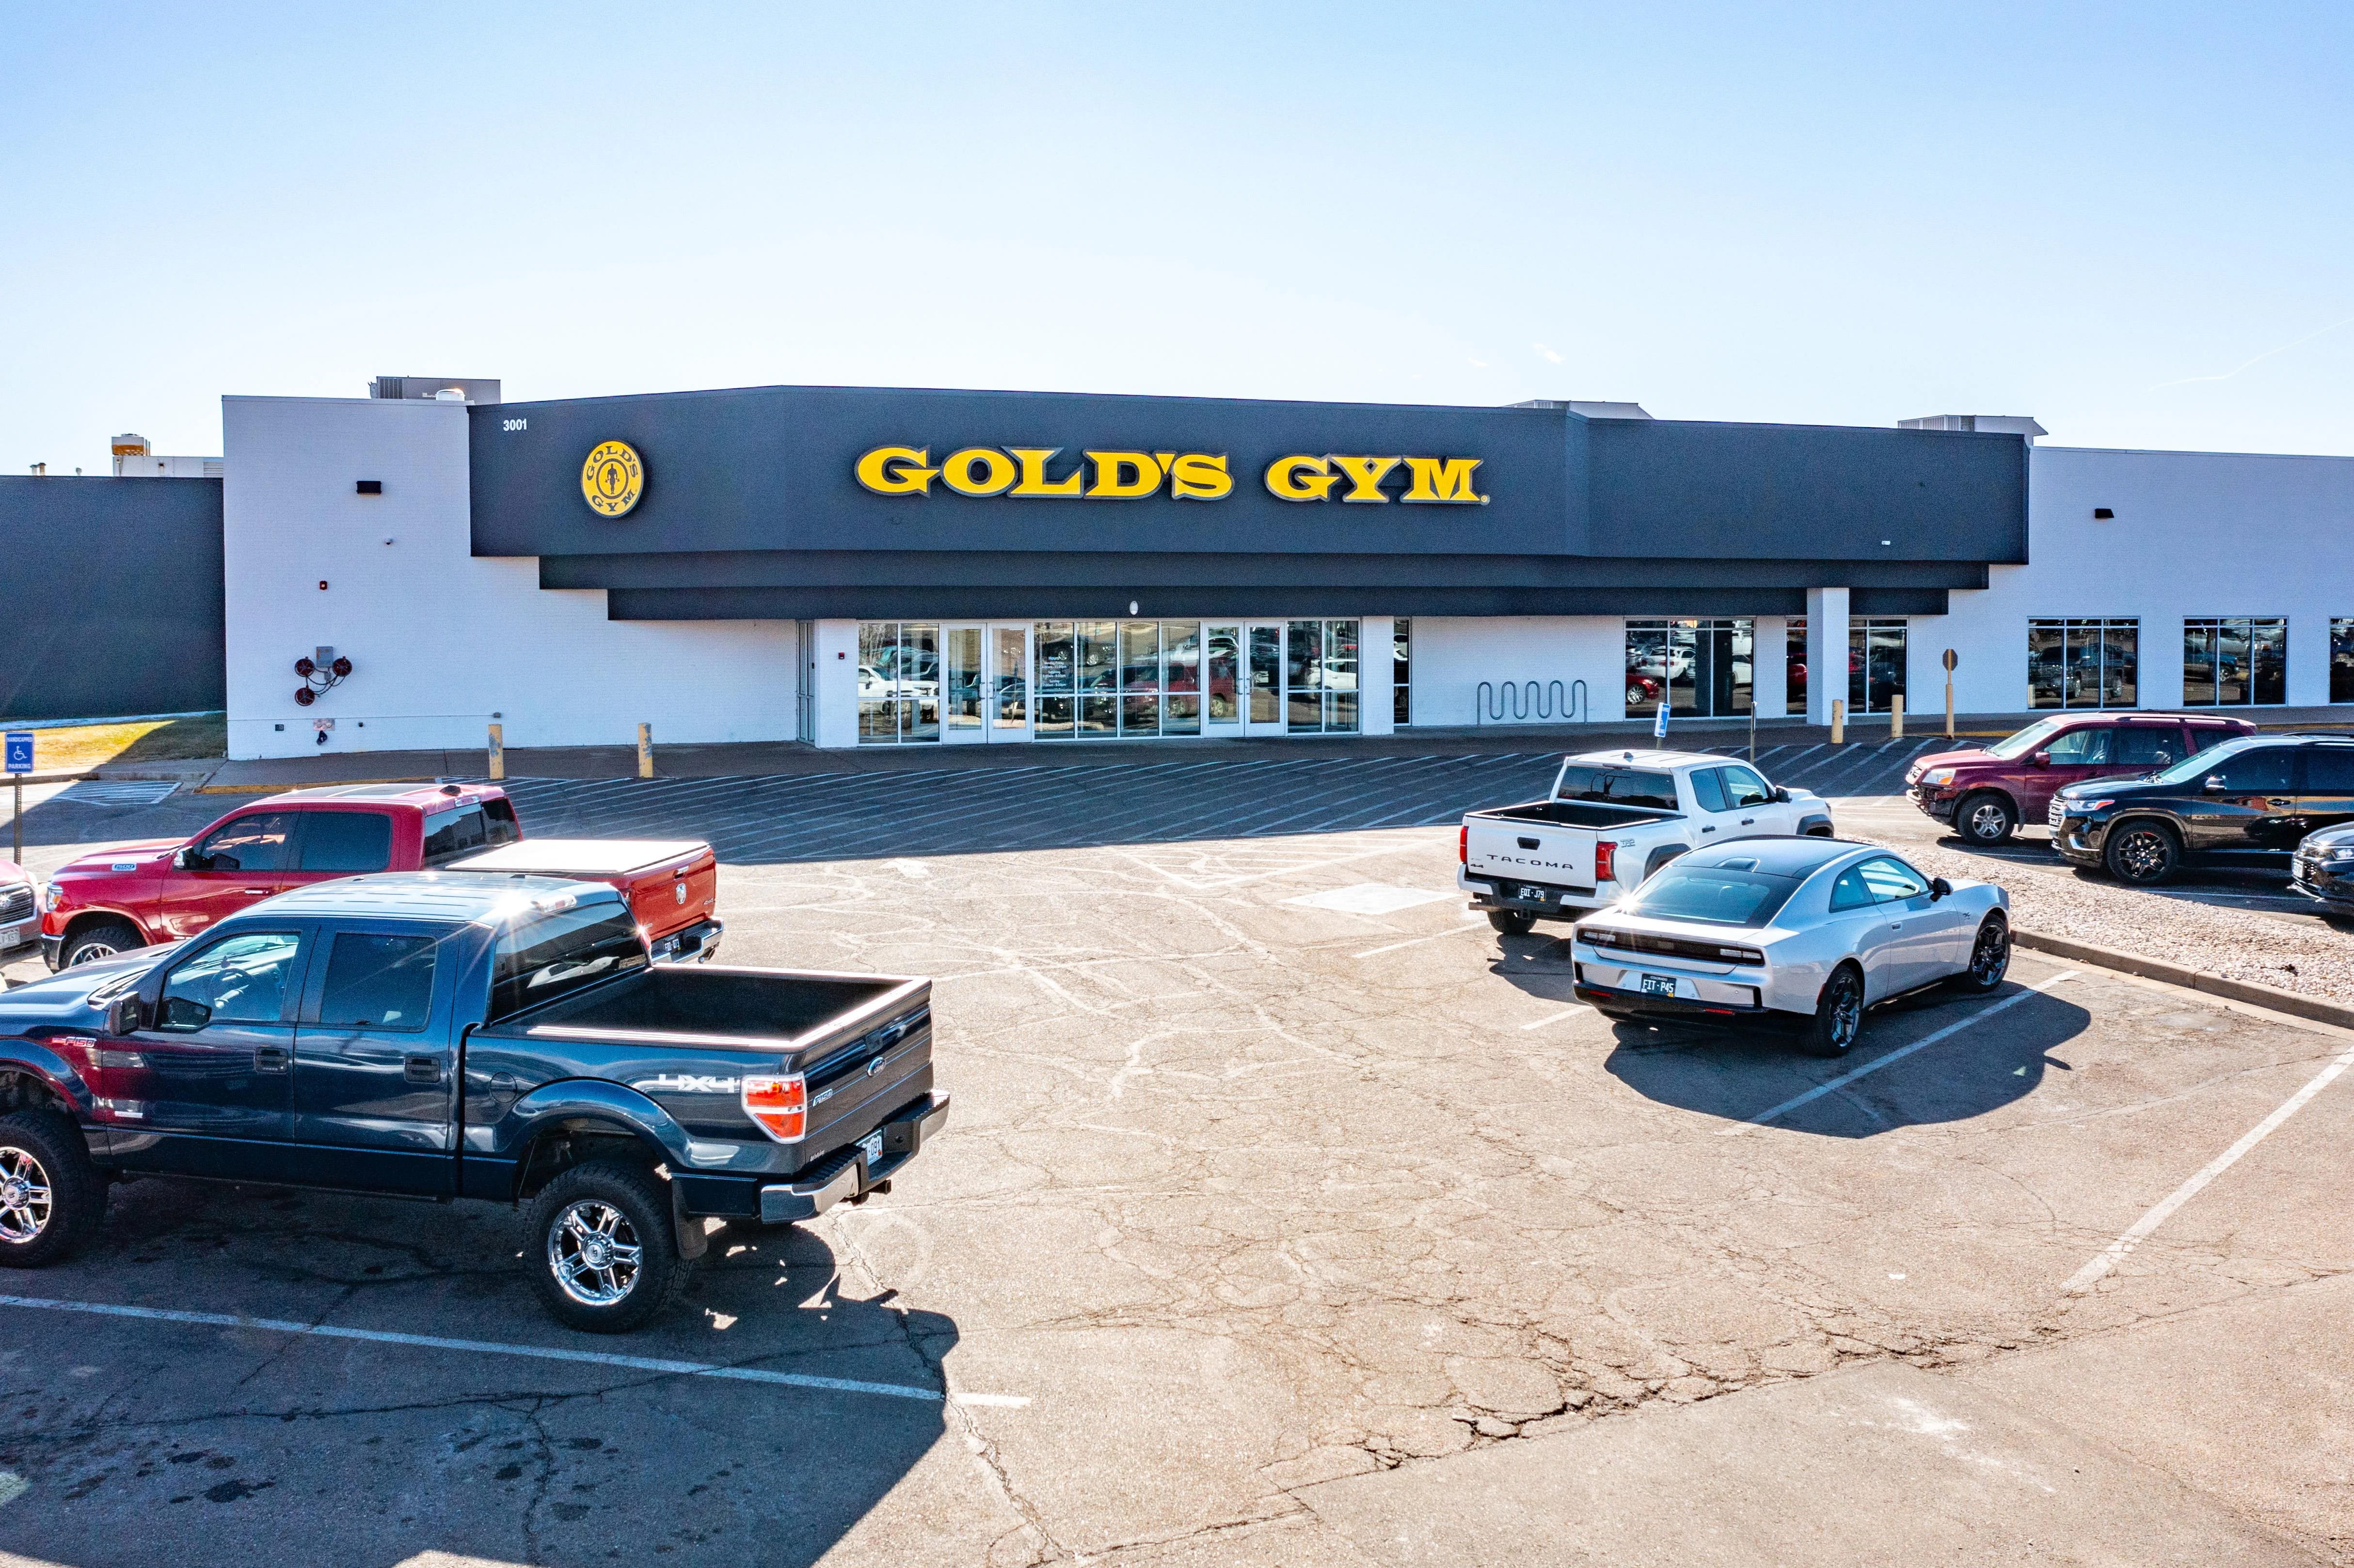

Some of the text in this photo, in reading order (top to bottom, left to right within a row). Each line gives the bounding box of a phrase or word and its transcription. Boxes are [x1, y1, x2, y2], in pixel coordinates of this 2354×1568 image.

[503, 418, 527, 431] 3001
[587, 445, 638, 481] GOLD'S
[856, 446, 1233, 499] GOLD'S
[592, 489, 636, 512] GYM
[1486, 855, 1574, 870] TACOMA
[1643, 979, 1674, 993] FIT-P45
